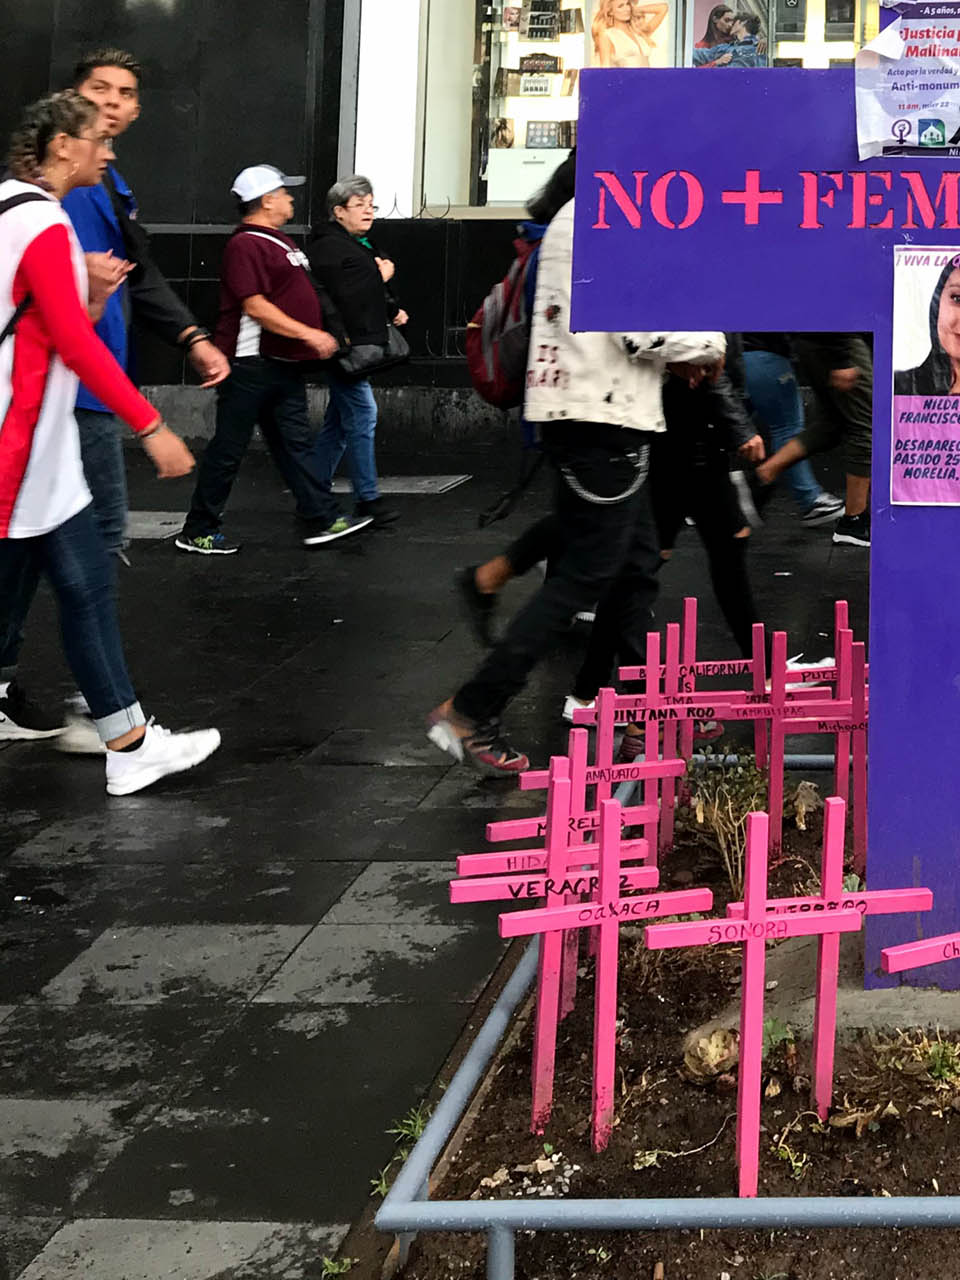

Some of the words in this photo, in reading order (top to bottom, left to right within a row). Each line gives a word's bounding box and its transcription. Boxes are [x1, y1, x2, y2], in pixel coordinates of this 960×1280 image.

[905, 69, 919, 77] por
[949, 148, 958, 156] Ni
[592, 170, 706, 230] NO
[934, 255, 948, 267] LA
[922, 398, 959, 411] NILDA
[893, 453, 941, 466] PASADO
[944, 453, 960, 466] 25
[903, 467, 960, 481] MORELIA,
[679, 663, 750, 679] CALIFORNIA
[686, 706, 715, 719] ROO
[507, 874, 634, 898] VERACRZ
[708, 920, 788, 944] SONORA
